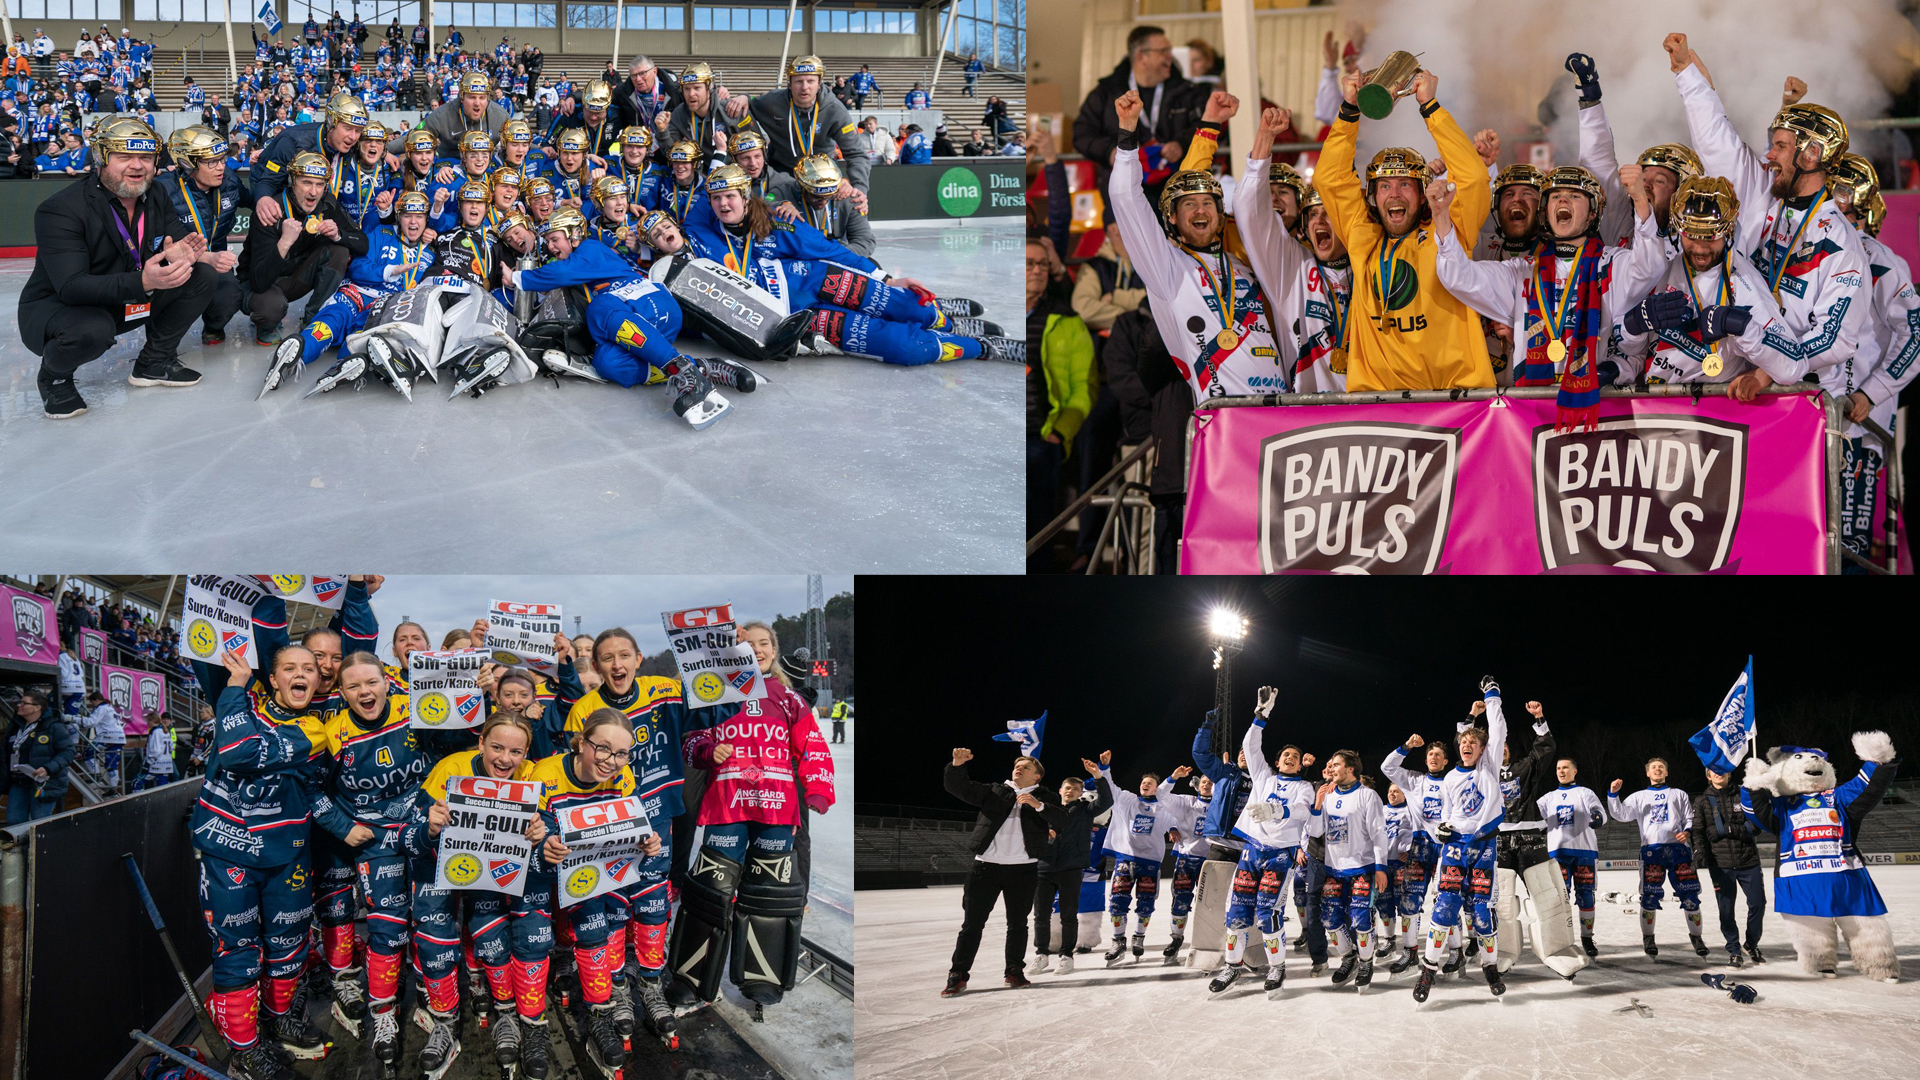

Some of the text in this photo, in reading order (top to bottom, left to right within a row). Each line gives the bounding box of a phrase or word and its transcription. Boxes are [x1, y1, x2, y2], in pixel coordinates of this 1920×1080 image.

[126, 139, 156, 151] LidPol
[708, 180, 728, 191] LidPol
[990, 173, 1021, 189] Dina
[942, 183, 978, 199] dina
[991, 192, 1026, 207] Försä
[381, 246, 398, 260] 25
[1326, 259, 1347, 267] evoko
[704, 264, 752, 290] JOFA
[822, 274, 842, 294] ICA
[1307, 266, 1325, 295] 9
[1836, 274, 1863, 289] aefab
[835, 271, 853, 304] KVANTUM
[130, 304, 146, 314] LAG
[688, 277, 764, 326] colorama
[1664, 327, 1708, 357] FÖNSTER
[1284, 445, 1434, 502] BANDY
[1557, 438, 1721, 499] BANDY
[1841, 450, 1855, 537] Bilmetro
[1855, 449, 1876, 531] Bilmetro
[1284, 500, 1416, 564] PULS
[1559, 494, 1704, 559] PULS
[190, 575, 261, 607] SM-GULD
[316, 582, 337, 593] KIS
[217, 597, 227, 608] till
[497, 601, 563, 616] GT
[16, 600, 41, 622] BANDY
[187, 597, 250, 631] Surte/Kareby
[672, 601, 736, 629] GT
[17, 614, 41, 635] PULS
[490, 615, 561, 634] SM-GULD
[86, 635, 103, 650] BANDY
[223, 636, 244, 650] KIS
[519, 631, 530, 640] till
[86, 646, 101, 661] PULS
[682, 654, 754, 673] Surte/Kareby
[111, 676, 131, 693] BANDY
[655, 682, 674, 691] INTER
[733, 671, 751, 688] KIS
[141, 681, 159, 696] BANDY
[657, 687, 674, 695] SPORT
[112, 690, 130, 708] PULS
[141, 693, 158, 709] PULS
[460, 697, 478, 714] KIS
[746, 698, 764, 717] 1
[376, 746, 394, 768] 4
[735, 745, 790, 761] ELICIT
[341, 751, 432, 790] Nouryon
[459, 777, 535, 804] GT
[1429, 784, 1440, 792] 29
[1561, 792, 1568, 801] 9
[1654, 793, 1666, 801] 20
[465, 797, 522, 812] Succén Uppsala
[748, 800, 783, 810] BYGG AB
[1335, 799, 1343, 810] 8
[570, 798, 637, 830] GT
[649, 809, 661, 819] AB
[483, 833, 495, 841] till
[580, 820, 635, 839] Succén Uppsala
[216, 834, 246, 852] BYGG
[444, 837, 528, 859] Surte/Kareby
[562, 847, 643, 870] Surte/Kareby
[1445, 845, 1462, 861] 23
[493, 863, 515, 877] KIS
[712, 869, 725, 882] 70
[750, 864, 762, 875] 70
[1238, 870, 1253, 881] ICA
[1446, 866, 1461, 876] ICA
[291, 868, 305, 887] S
[522, 892, 550, 905] ekan
[648, 899, 666, 907] TEAM
[639, 905, 666, 913] SPORTIA
[586, 912, 605, 923] TEAM
[579, 921, 607, 931] SPORTIA
[477, 946, 504, 957] SPORTIA
[482, 938, 502, 950] TEAM
[436, 950, 455, 961] TEAM
